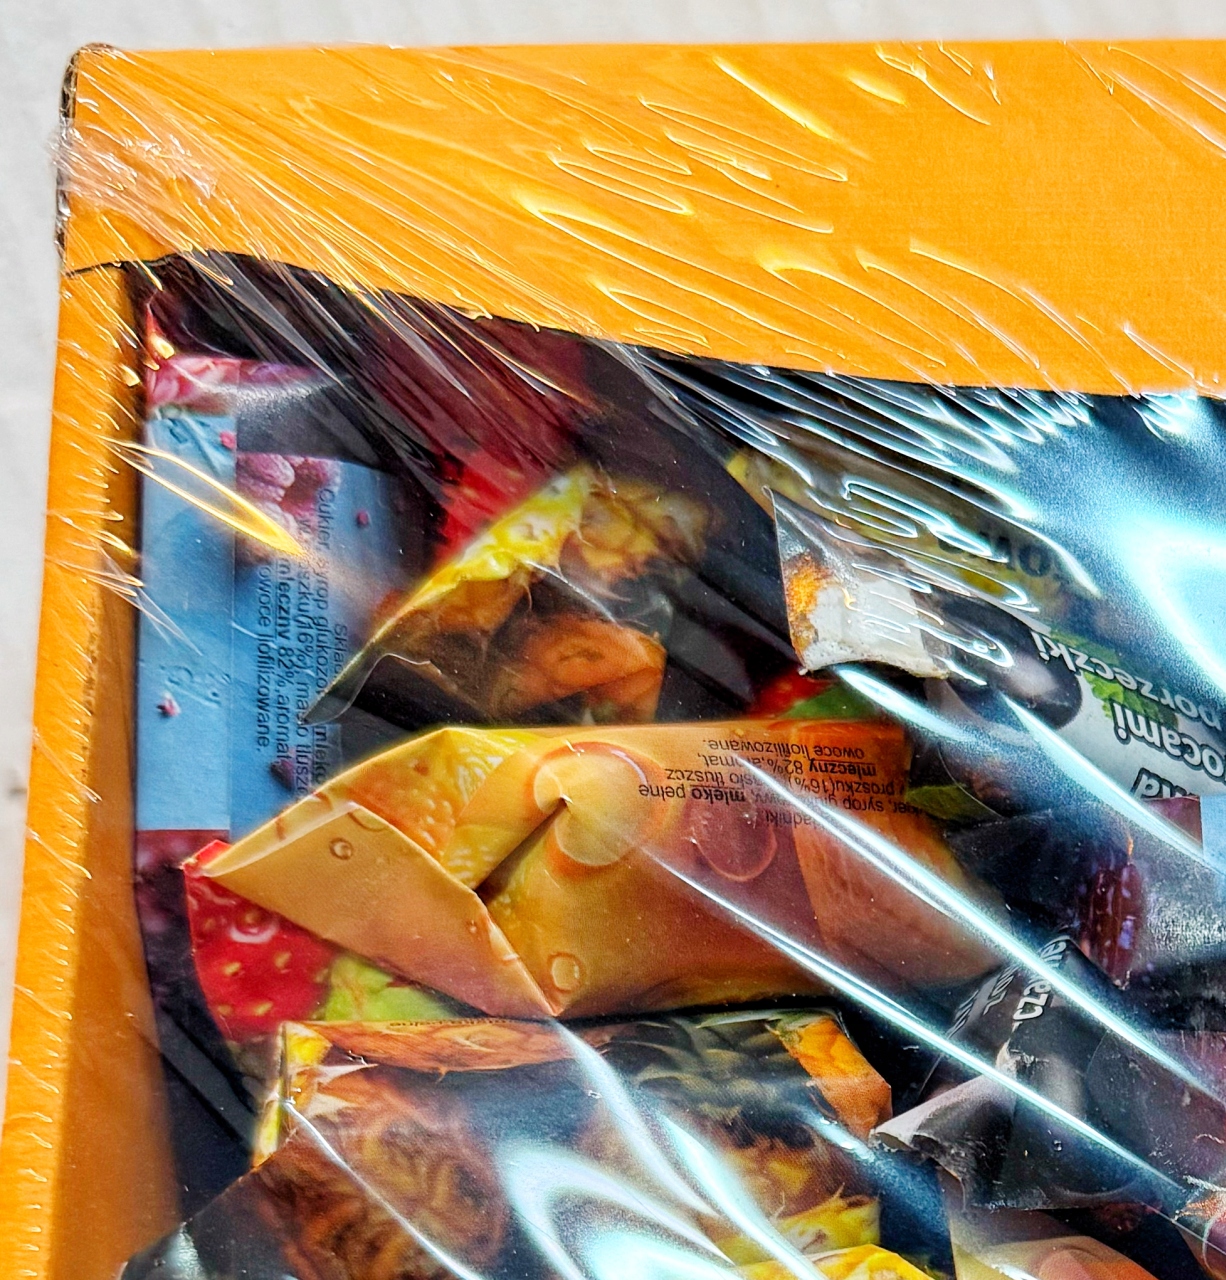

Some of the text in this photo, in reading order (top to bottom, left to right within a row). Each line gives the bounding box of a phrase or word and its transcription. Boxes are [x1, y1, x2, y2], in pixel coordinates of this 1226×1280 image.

[258, 566, 273, 627] owoce
[1031, 626, 1224, 735] porzeczki
[813, 744, 866, 760] owoce
[665, 767, 725, 786] tłuszcz
[808, 761, 878, 778] mleczny
[638, 782, 687, 801] pełne
[690, 784, 746, 803] mleko
[843, 797, 885, 812] syrop
